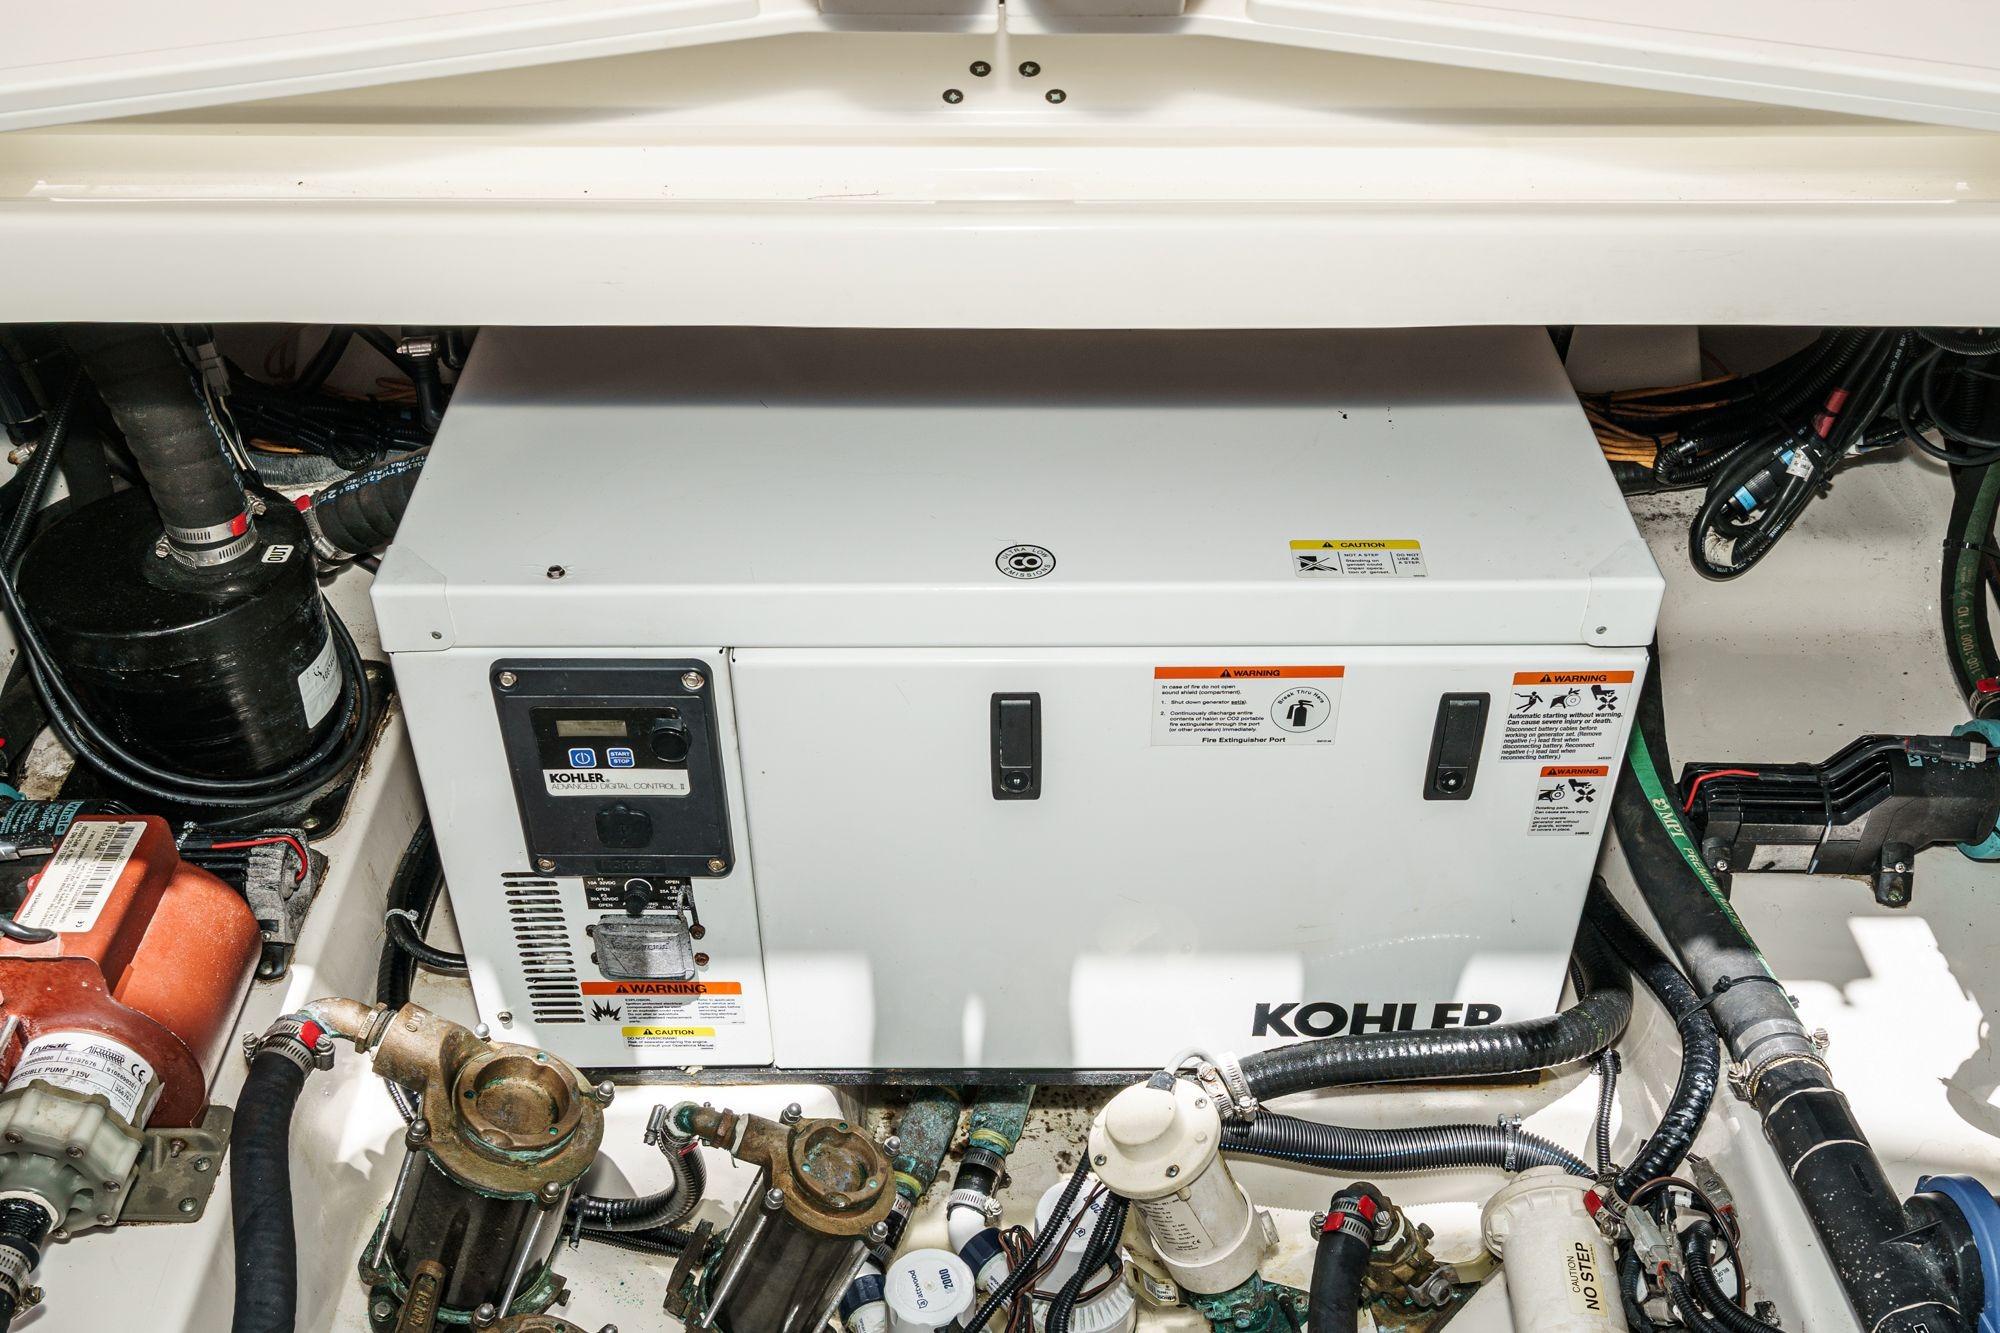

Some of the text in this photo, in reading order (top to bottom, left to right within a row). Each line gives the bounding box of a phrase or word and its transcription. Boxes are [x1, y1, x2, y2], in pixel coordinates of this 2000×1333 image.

[267, 546, 288, 561] OUT
[1001, 547, 1048, 560] ULTRA LOW
[1004, 564, 1051, 577] EMISSIONS
[1278, 692, 1294, 705] Break
[1313, 693, 1324, 703] Here
[55, 802, 80, 833] Whale
[1659, 810, 1685, 838] MPI
[1683, 847, 1723, 895] PREMIUM
[628, 984, 707, 993] WARNING
[72, 1070, 91, 1079] 115V
[939, 1268, 954, 1289] 2000
[1567, 1256, 1580, 1293] CAUTION
[1575, 1242, 1600, 1310] NO STEP
[908, 1269, 924, 1299] attwood
